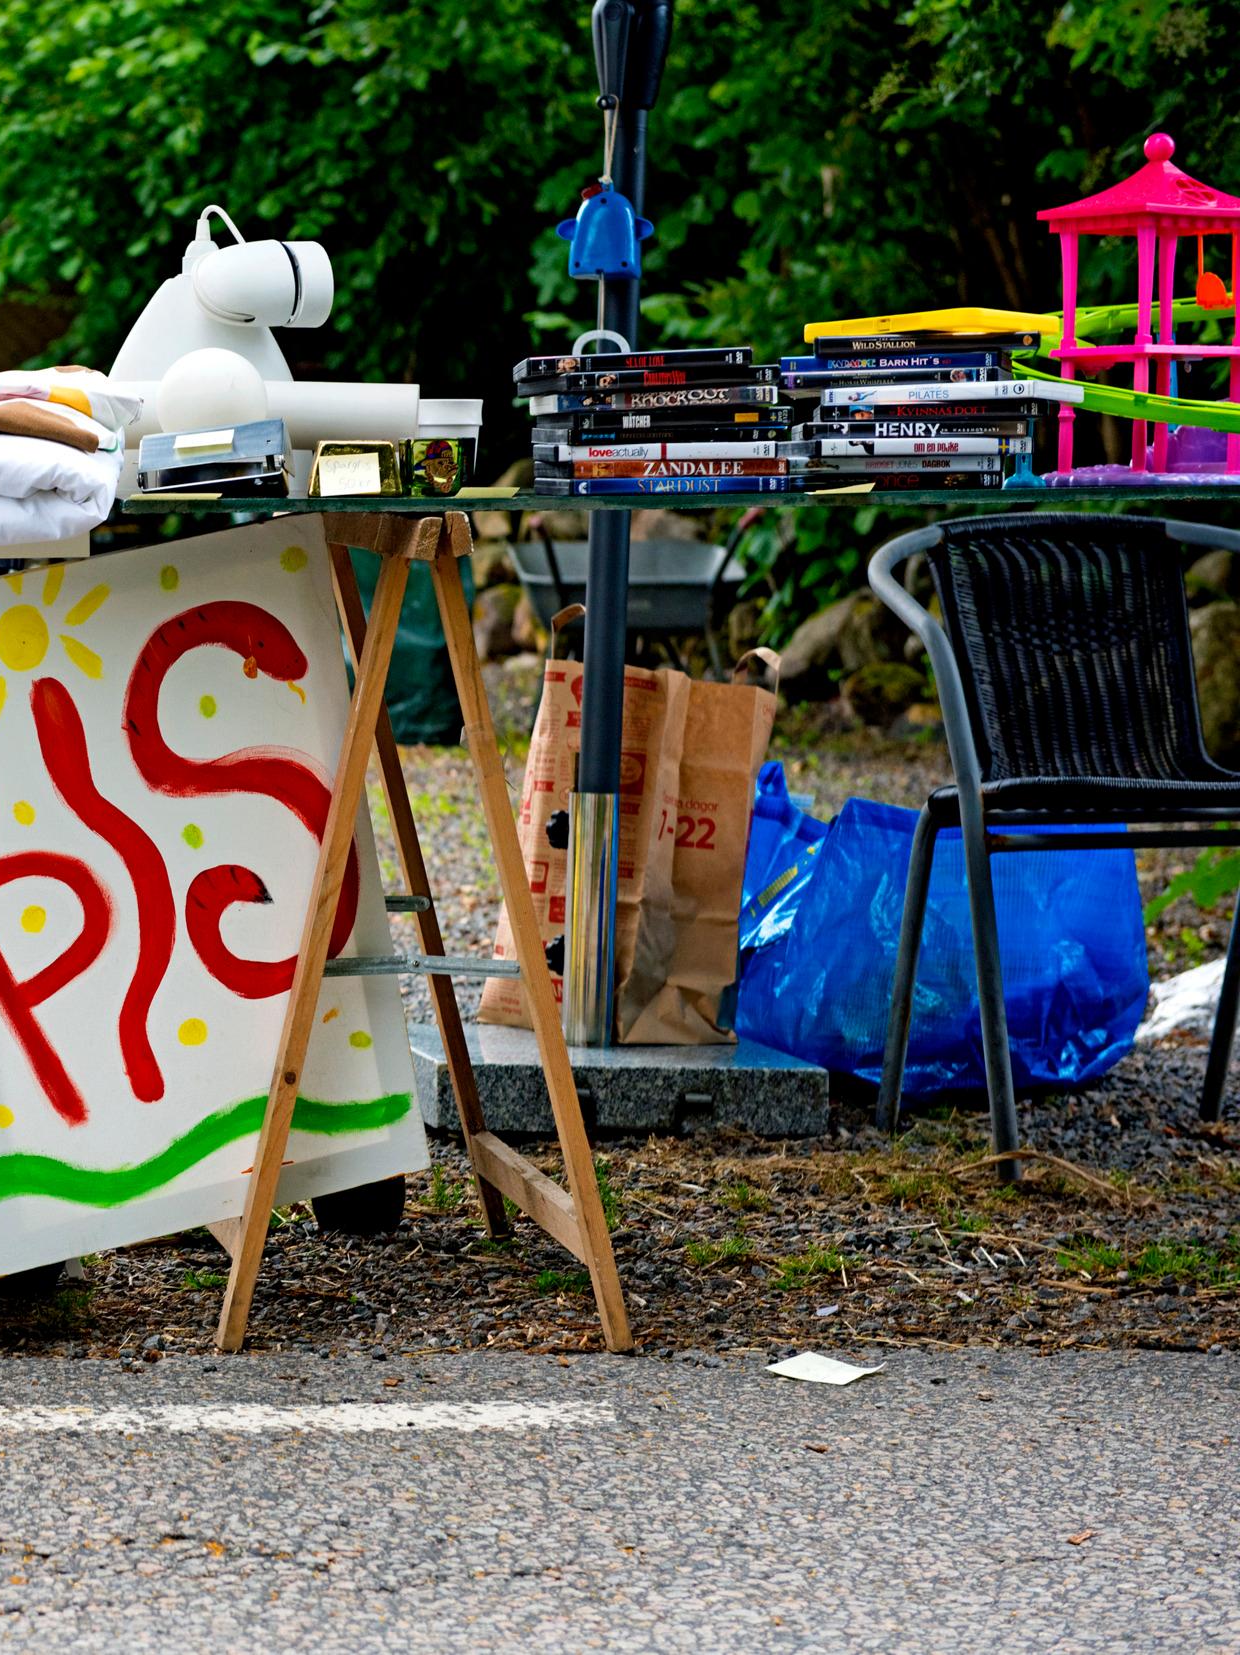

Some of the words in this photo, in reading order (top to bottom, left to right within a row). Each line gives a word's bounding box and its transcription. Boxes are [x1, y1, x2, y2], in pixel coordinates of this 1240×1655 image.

[852, 341, 875, 350] WILD
[875, 340, 916, 350] STALLION
[879, 359, 909, 368] BARN
[908, 390, 950, 400] PILATES
[897, 406, 952, 416] KVINNAS
[875, 423, 940, 437] HENRY
[643, 461, 745, 476] ZANDALEE
[922, 460, 951, 468] DAGBOK
[637, 479, 721, 493] STARDUST
